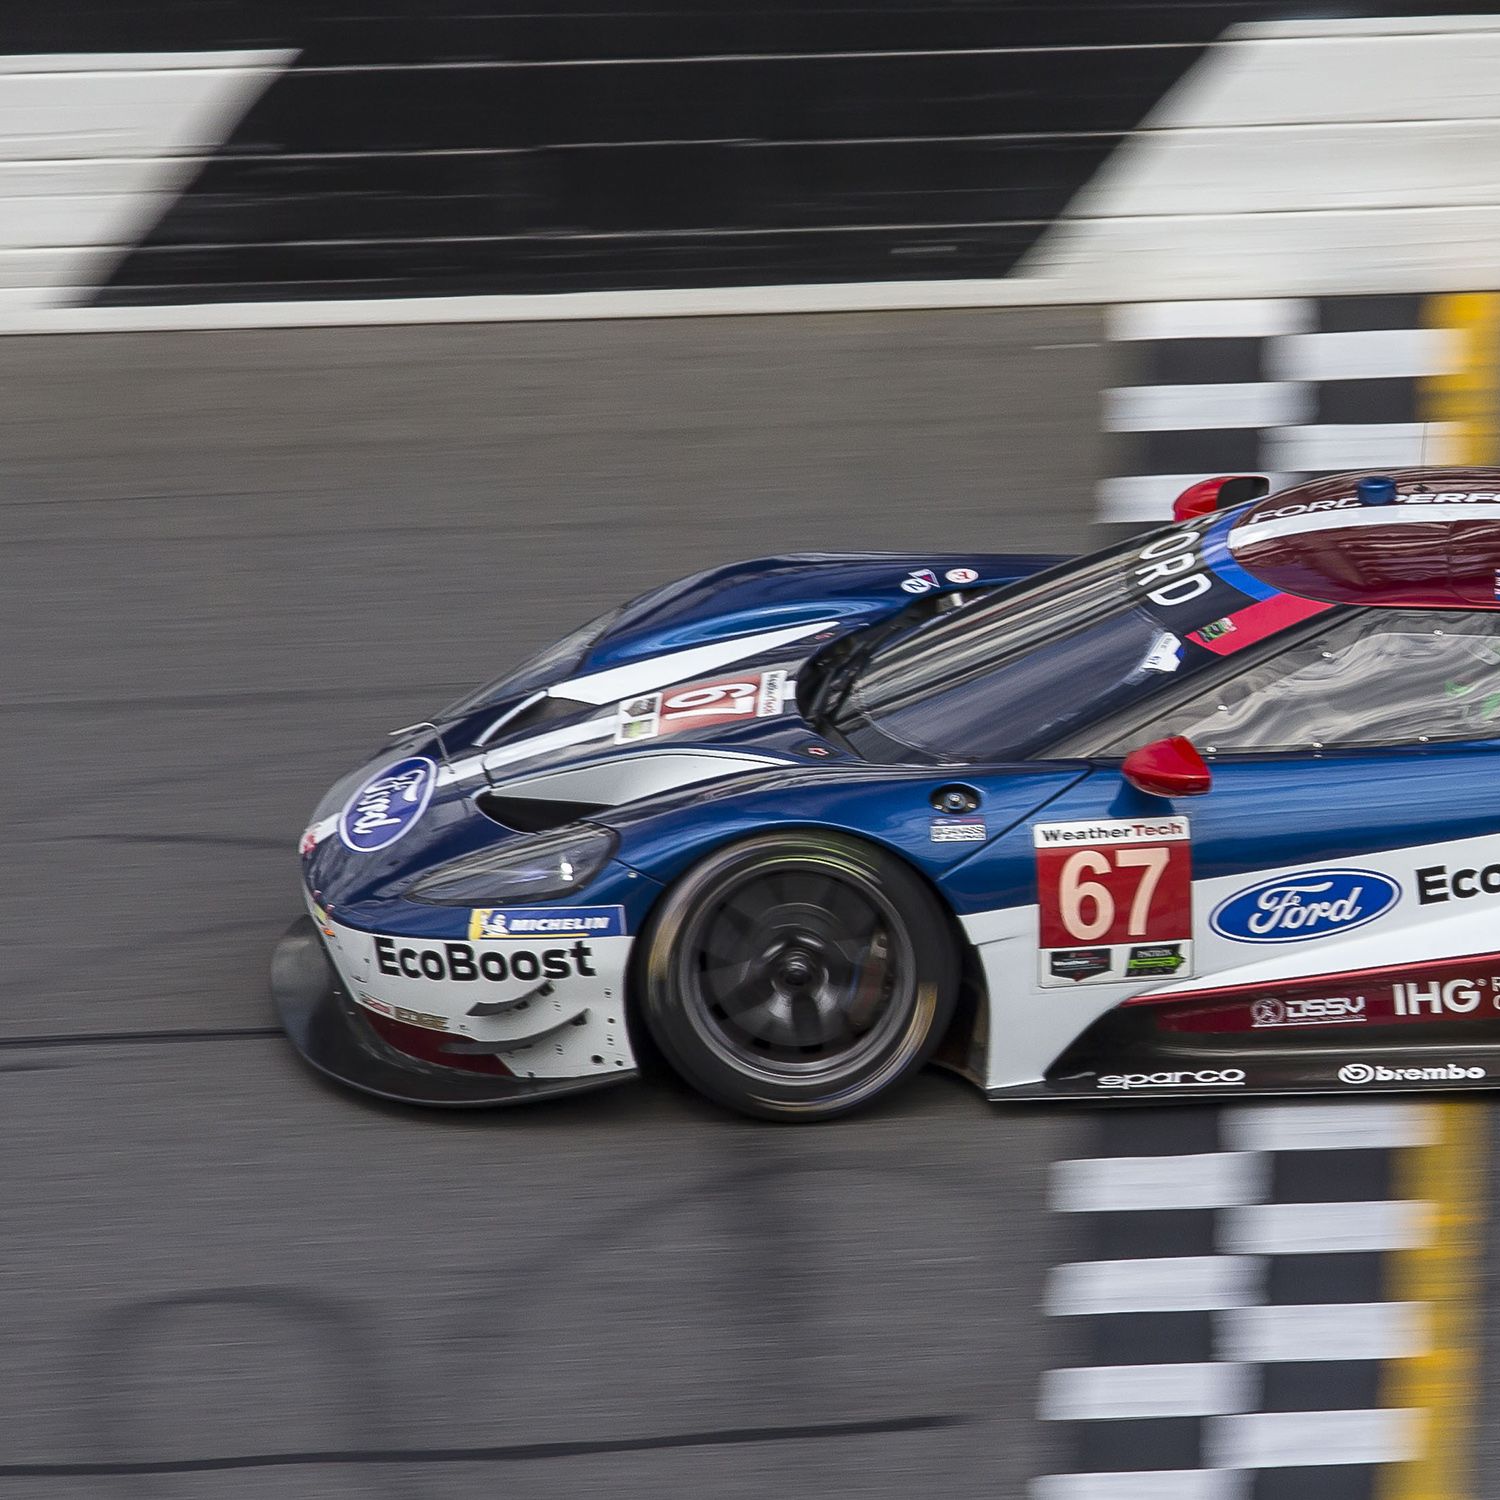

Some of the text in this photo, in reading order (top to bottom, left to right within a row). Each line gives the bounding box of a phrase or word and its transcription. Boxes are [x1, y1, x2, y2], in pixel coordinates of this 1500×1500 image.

[663, 683, 758, 721] 67
[352, 769, 426, 834] Ford
[1041, 822, 1185, 842] WeatherTech
[1059, 847, 1171, 940] 67
[1248, 881, 1363, 934] Ford
[508, 916, 611, 932] MICHELIN
[374, 936, 597, 982] EcoBoost
[1285, 996, 1366, 1018] DSSV
[1098, 1069, 1246, 1088] sparco
[1374, 1063, 1486, 1081] brembo
